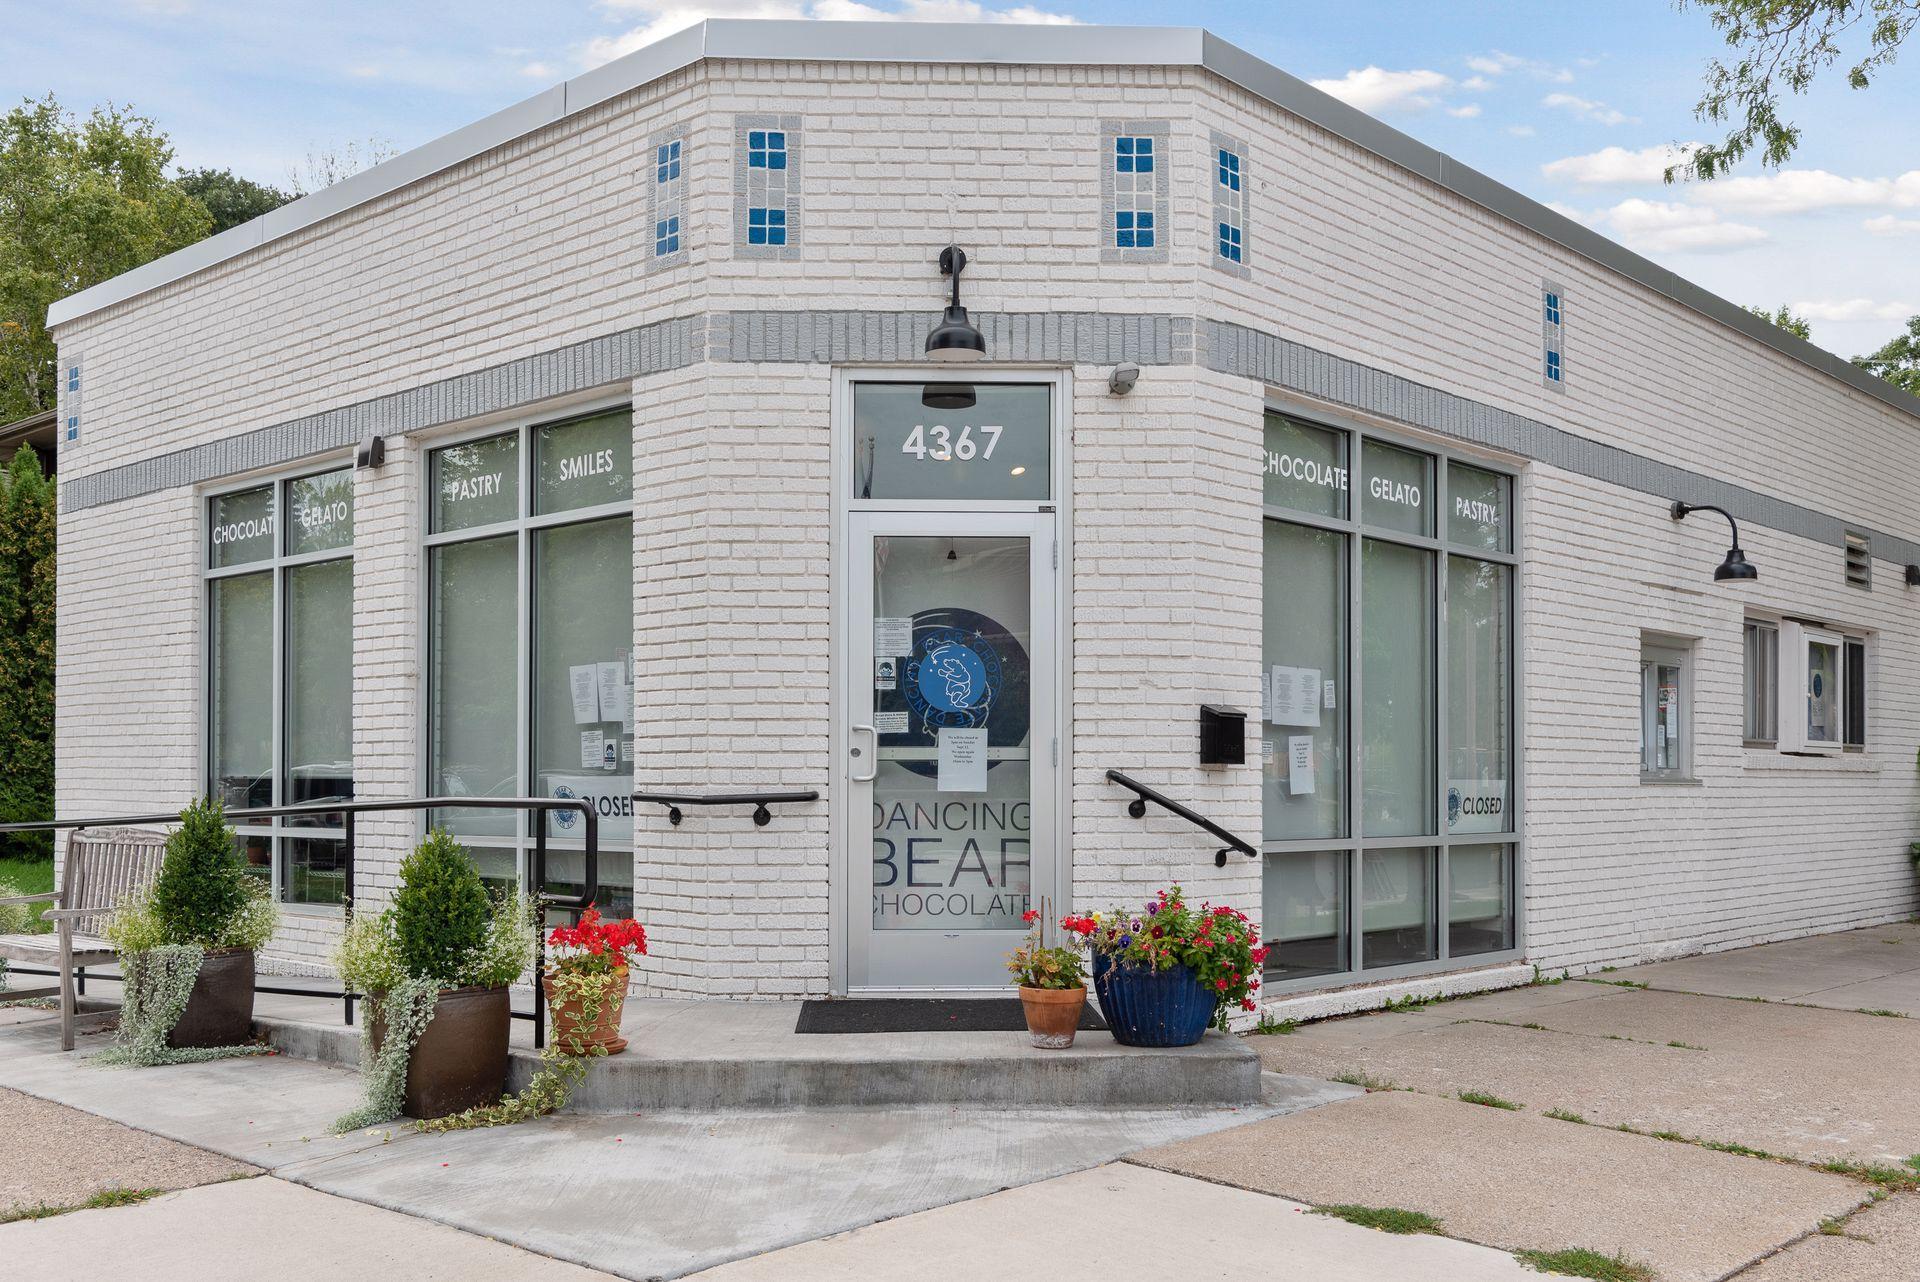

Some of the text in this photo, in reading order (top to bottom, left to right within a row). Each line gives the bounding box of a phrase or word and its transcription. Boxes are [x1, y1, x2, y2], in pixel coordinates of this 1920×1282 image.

[902, 425, 1004, 461] 4367
[560, 449, 614, 481] SMILES
[452, 472, 502, 502] PASTRY
[1370, 476, 1421, 508] GELATO
[302, 501, 348, 527] GELATO
[1456, 496, 1497, 525] PASTRY
[213, 515, 275, 545] CHOCOLAT
[581, 795, 634, 817] LOSE
[1462, 796, 1502, 815] CLOSED
[873, 894, 1030, 916] HOCOLAT
